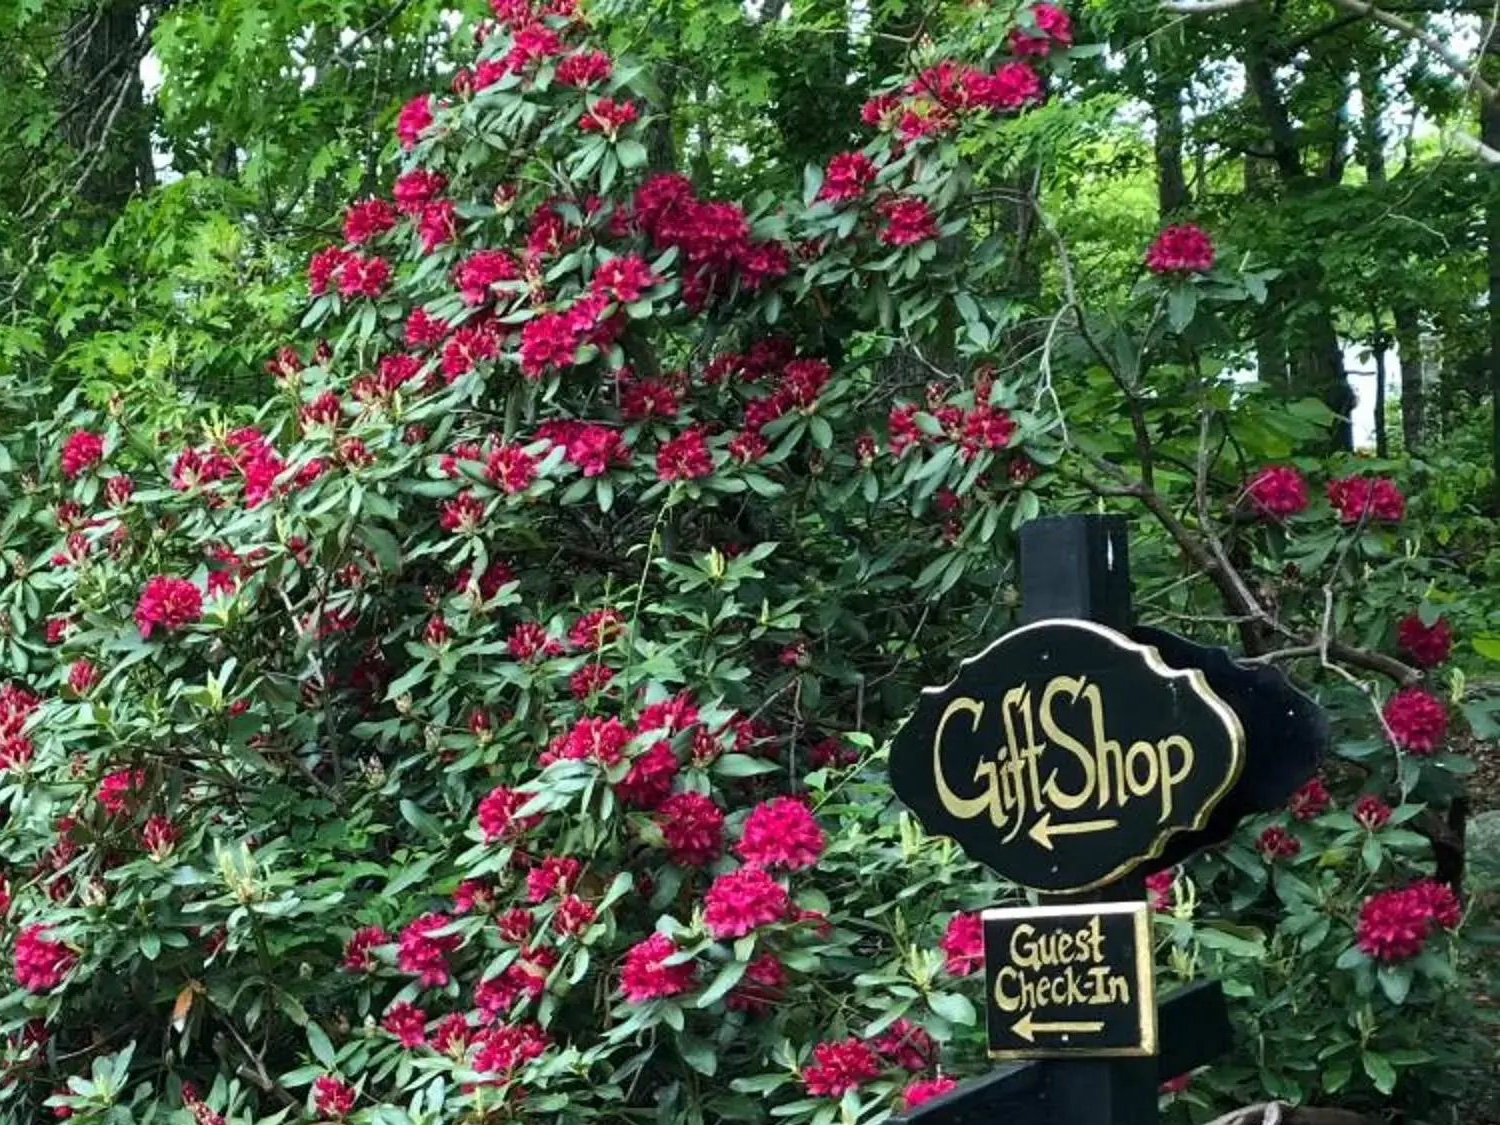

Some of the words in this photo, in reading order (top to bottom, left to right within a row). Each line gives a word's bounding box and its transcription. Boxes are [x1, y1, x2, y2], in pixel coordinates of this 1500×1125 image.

[933, 682, 1046, 844] Gift
[1039, 675, 1194, 824] Shop
[1010, 915, 1106, 971] Guest
[994, 965, 1130, 1012] Check-In
